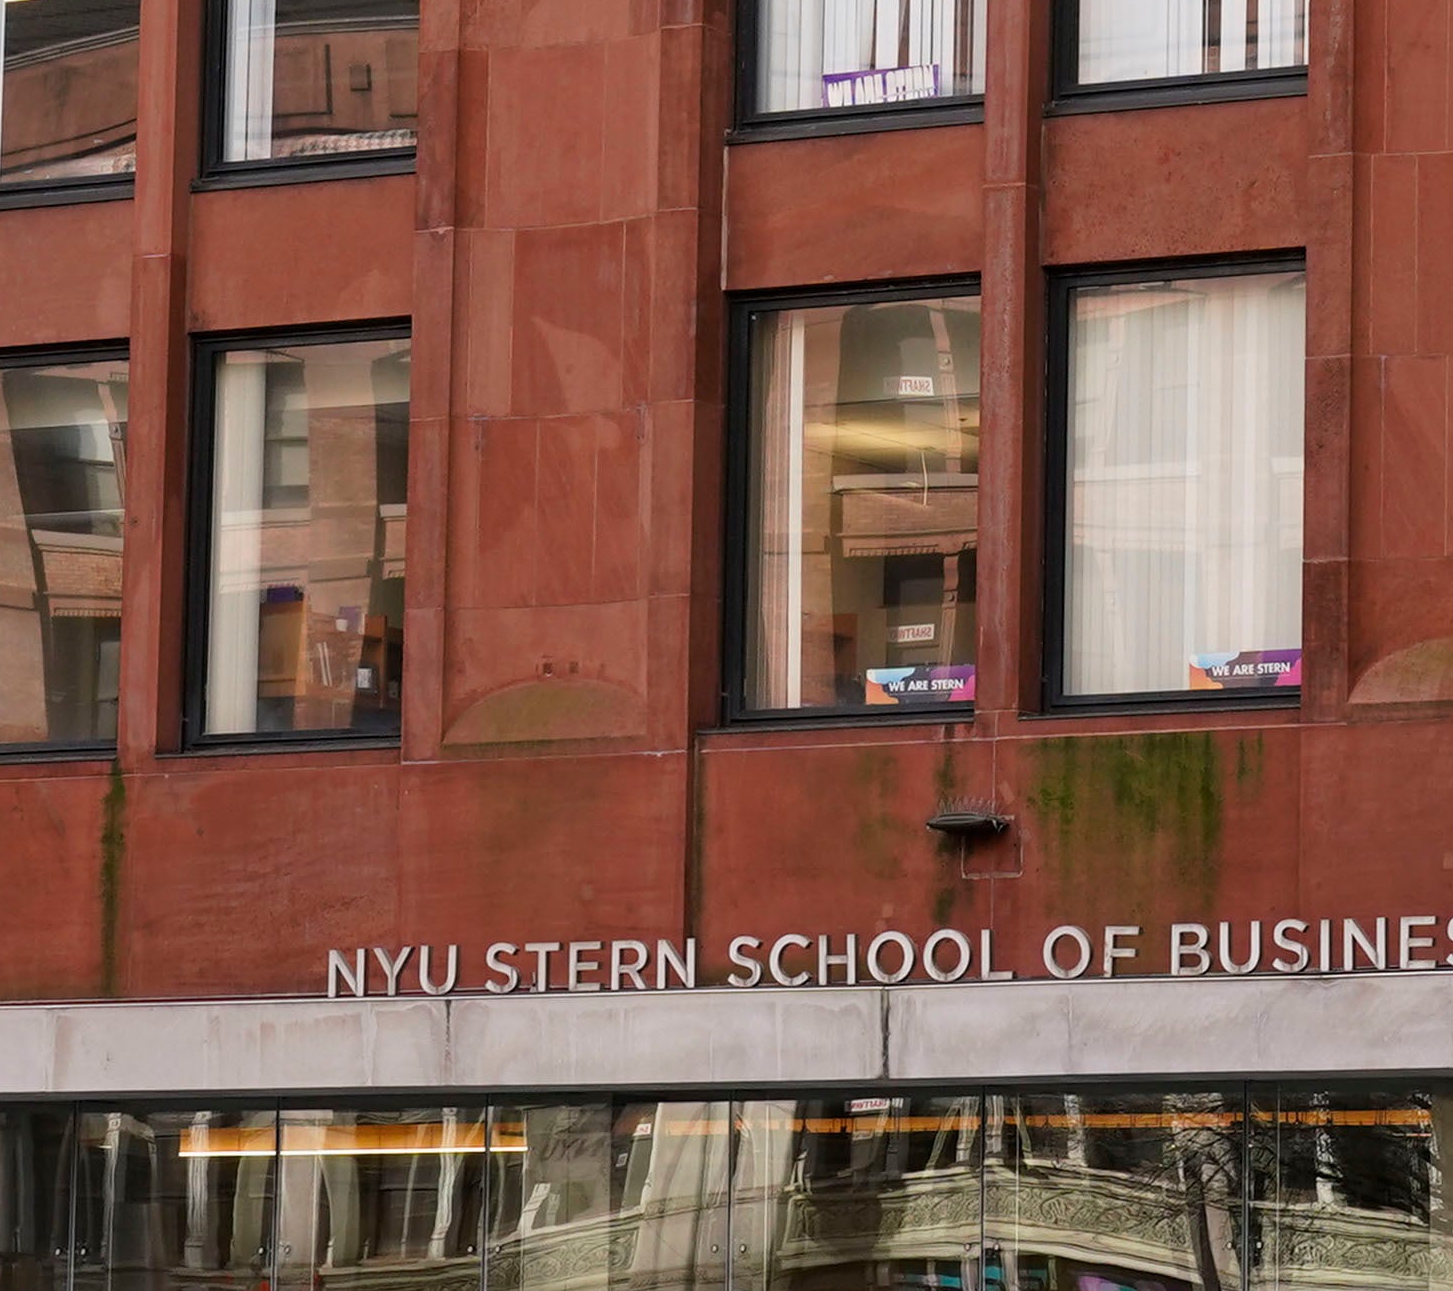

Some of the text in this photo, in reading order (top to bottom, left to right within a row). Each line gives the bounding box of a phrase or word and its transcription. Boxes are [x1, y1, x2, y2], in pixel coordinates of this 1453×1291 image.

[1211, 662, 1291, 676] WE ARE STERN
[888, 678, 964, 692] WE ARE STERN
[327, 945, 458, 998] NYU
[484, 937, 695, 995] STERN
[727, 928, 1013, 988] SCHOOL
[1042, 924, 1140, 979] OF
